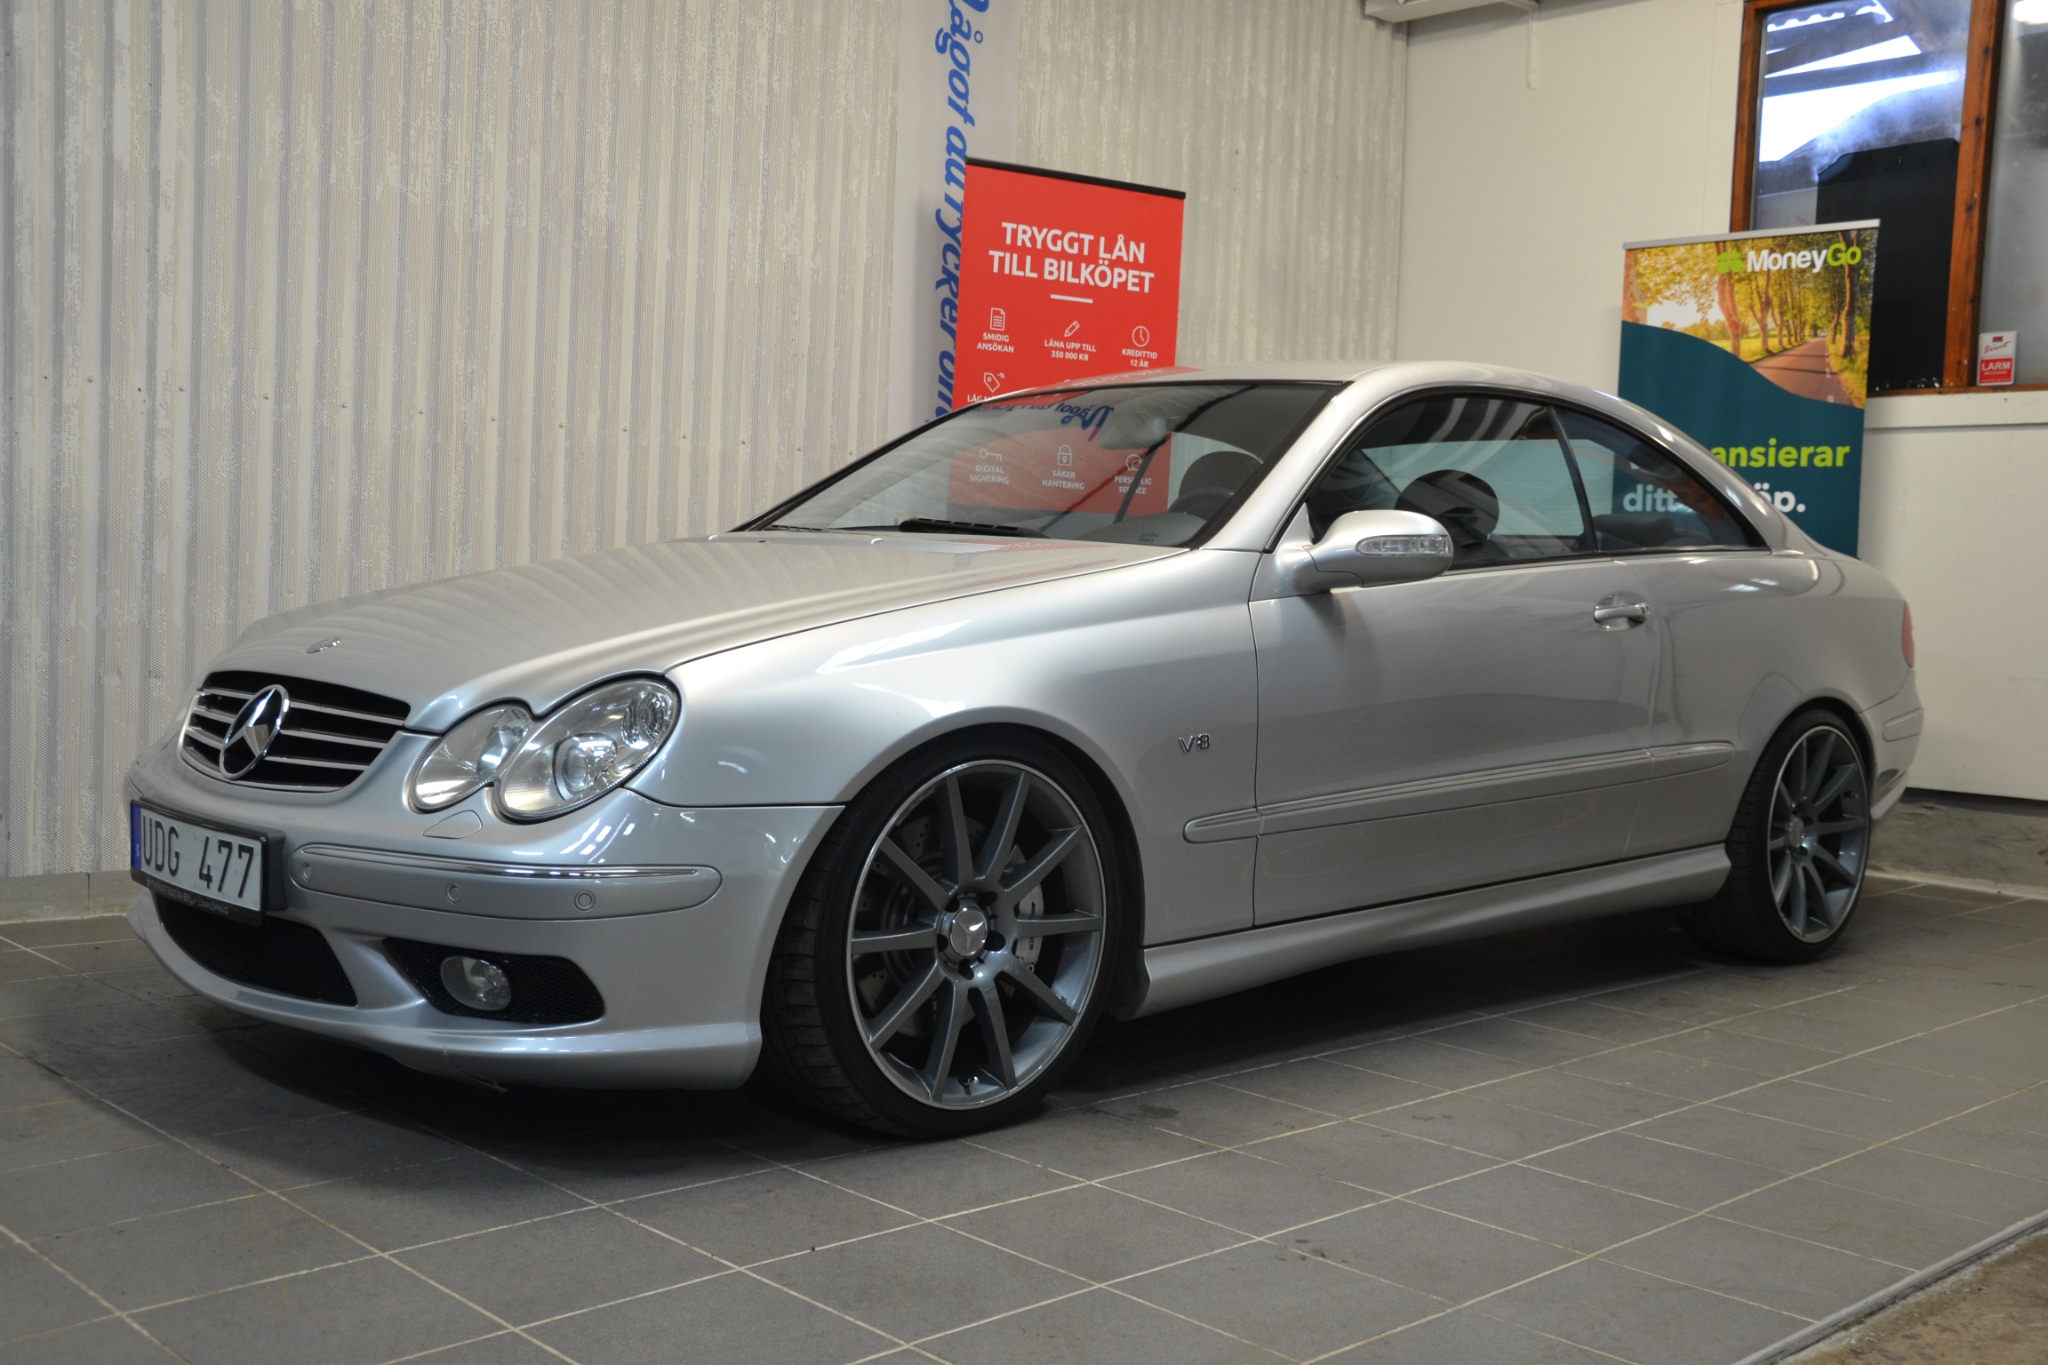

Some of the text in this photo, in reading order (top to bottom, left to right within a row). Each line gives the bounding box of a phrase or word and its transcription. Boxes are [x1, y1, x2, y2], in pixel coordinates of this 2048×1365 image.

[1002, 221, 1146, 264] TRYGGT LÅN
[1746, 242, 1862, 273] MoneyGo
[988, 249, 1155, 294] TILL BILKÖPET
[983, 332, 1010, 343] SMIDIG
[976, 342, 1015, 354] ANSÖKAN
[1044, 339, 1097, 352] LÅNA UPP TILL
[1051, 351, 1089, 362] 350 000 KR
[1121, 348, 1158, 360] KREDITTID
[1130, 359, 1149, 369] 12 ÅR
[1981, 361, 2011, 371] LARM
[1711, 437, 1851, 468] ansierar
[975, 464, 1005, 474] DIGITAL
[1052, 469, 1076, 479] SÄKER
[968, 474, 1010, 485] SIGNERING
[1042, 479, 1085, 490] HANTERING
[1114, 475, 1153, 486] PERSLIG
[1118, 486, 1147, 495] SEICE
[1622, 482, 1806, 513] ditt öp.
[1178, 732, 1211, 753] V8
[143, 814, 254, 899] UDG 477
